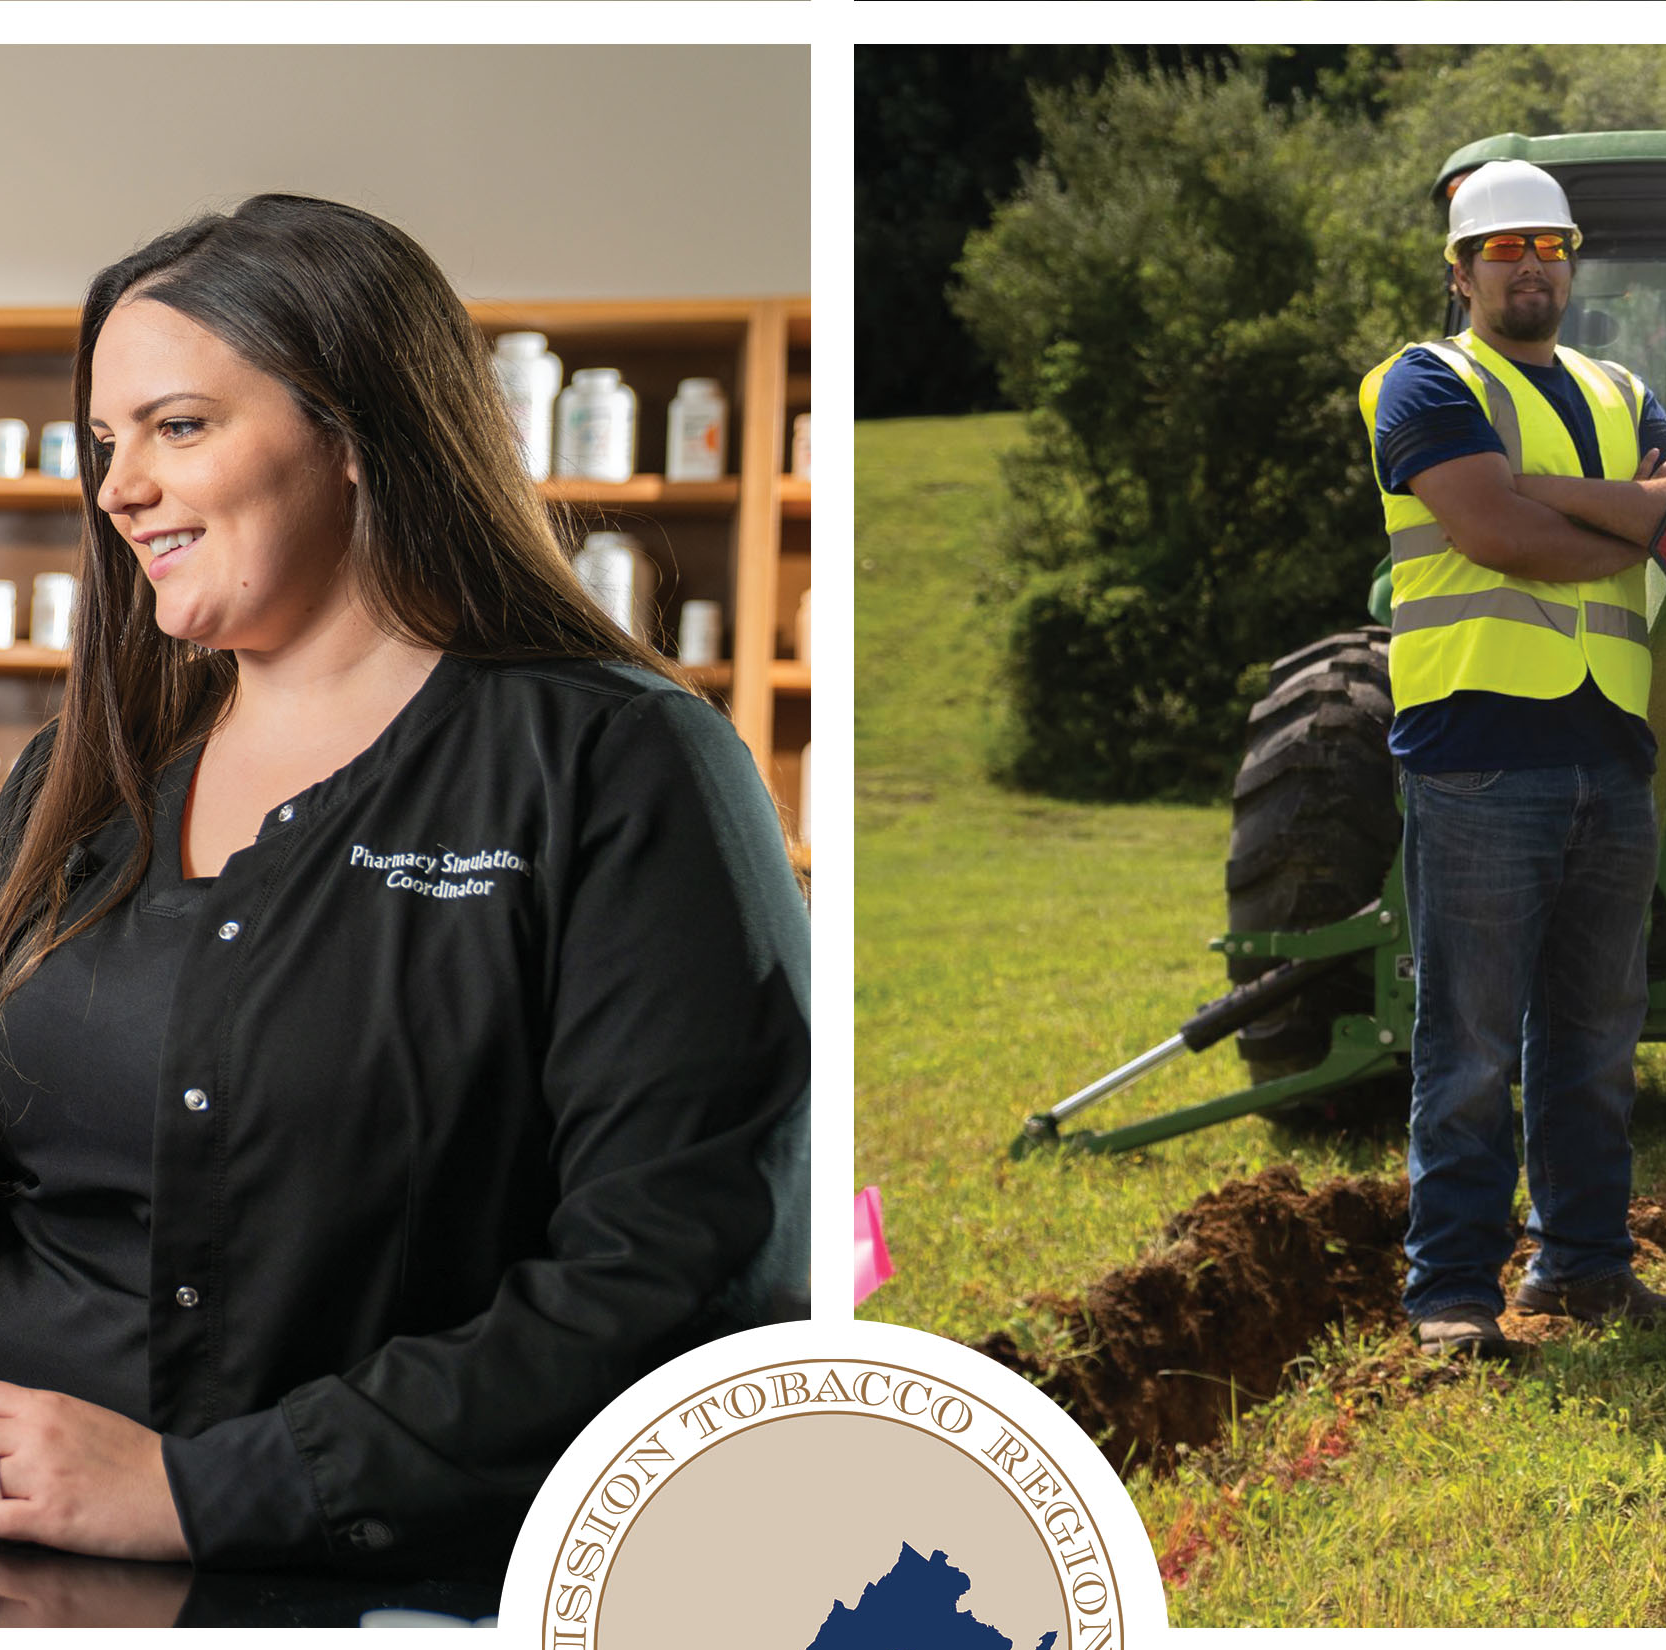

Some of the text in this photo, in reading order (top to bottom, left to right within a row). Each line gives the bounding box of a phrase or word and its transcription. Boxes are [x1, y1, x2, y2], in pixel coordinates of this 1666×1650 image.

[350, 845, 531, 877] Pharmacy Simulation
[386, 870, 495, 900] Coordinator
